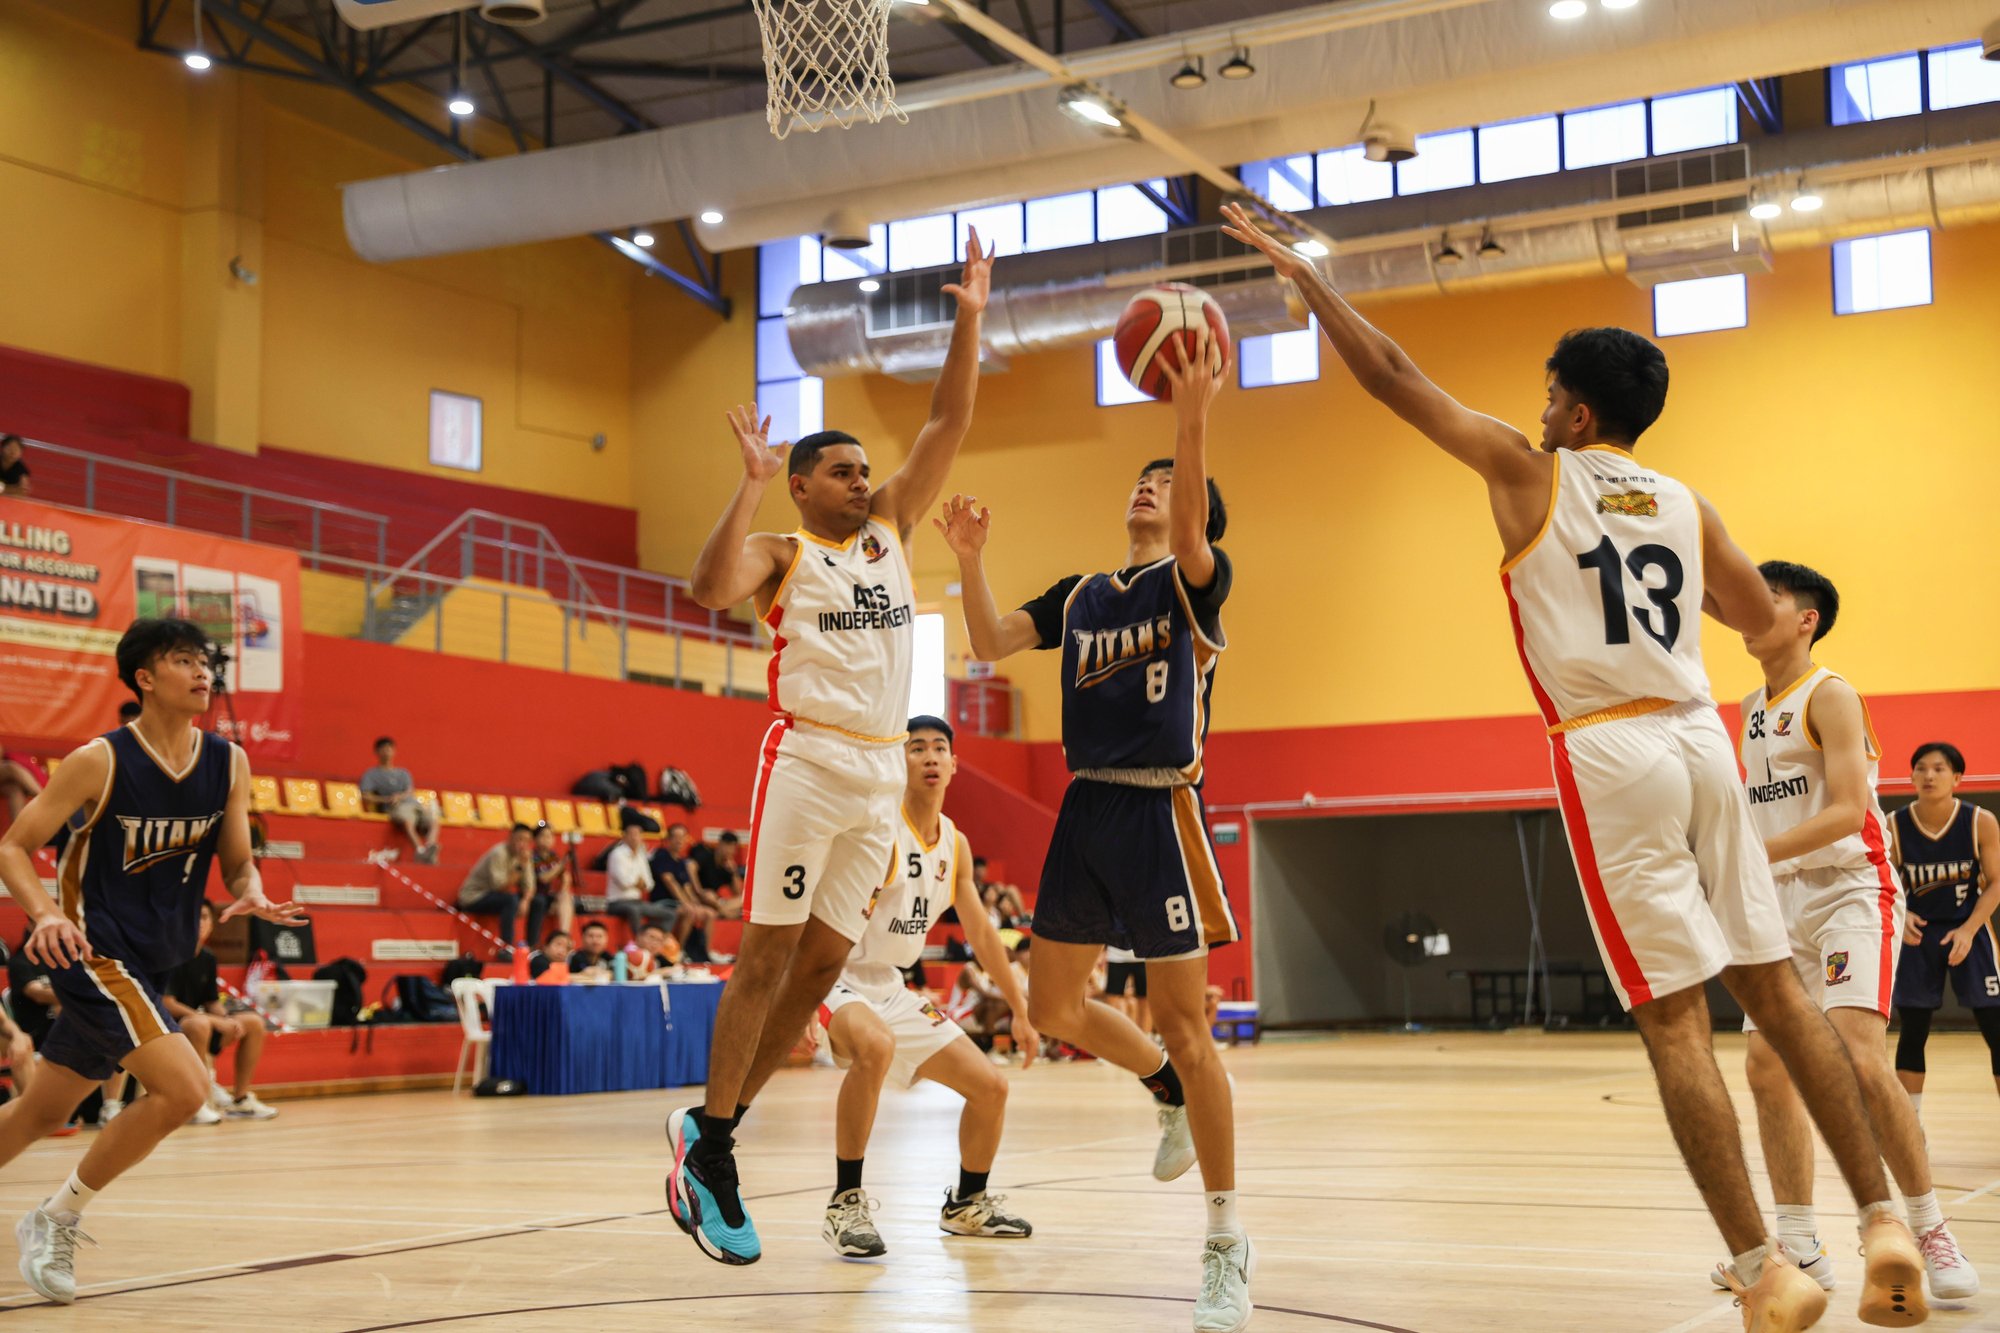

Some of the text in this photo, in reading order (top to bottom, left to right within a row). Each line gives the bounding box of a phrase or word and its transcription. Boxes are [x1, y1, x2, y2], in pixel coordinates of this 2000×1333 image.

[24, 555, 98, 581] ACCOUNT
[1, 576, 96, 614] NATED
[1577, 535, 1684, 653] 13
[1074, 612, 1171, 682] TITANS
[1146, 660, 1169, 704] 8
[782, 865, 806, 900] 3
[1904, 859, 1973, 893] TITANS
[1165, 895, 1190, 932] 8
[1955, 884, 1969, 907] 5
[1984, 976, 2000, 996] 5
